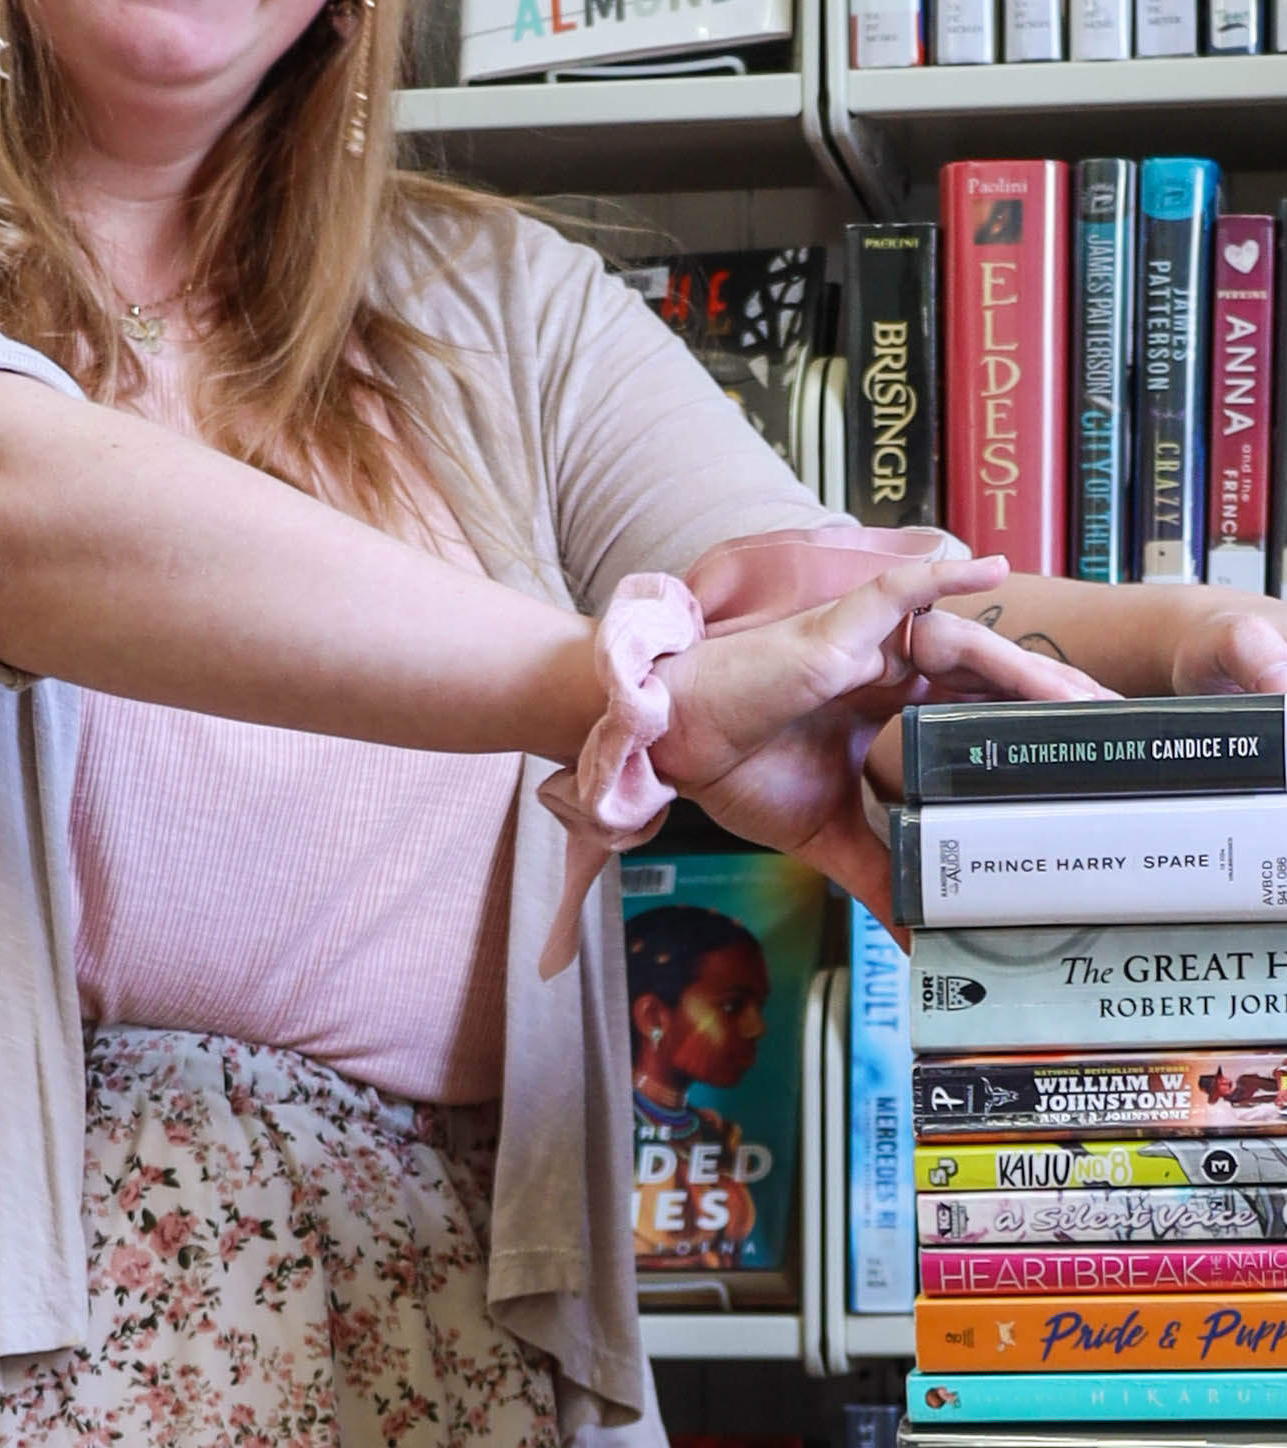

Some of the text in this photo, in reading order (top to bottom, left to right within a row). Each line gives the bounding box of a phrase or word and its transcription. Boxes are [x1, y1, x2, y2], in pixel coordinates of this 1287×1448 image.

[968, 178, 1027, 195] Paolini
[1148, 260, 1172, 391] PATTERSON
[980, 261, 1021, 531] ELDEST
[1224, 314, 1255, 436] ANNA
[863, 321, 918, 505] BRISINGR
[1008, 737, 1259, 764] GATHERING DARK CANDICE FOX
[971, 854, 1210, 873] PRINCE HARRY SPARE
[1262, 860, 1273, 905] AVBCD
[1034, 1074, 1191, 1093] WILLIAM W.
[940, 1256, 1206, 1293] HEARTBREAK
[1041, 1310, 1148, 1361] Pride
